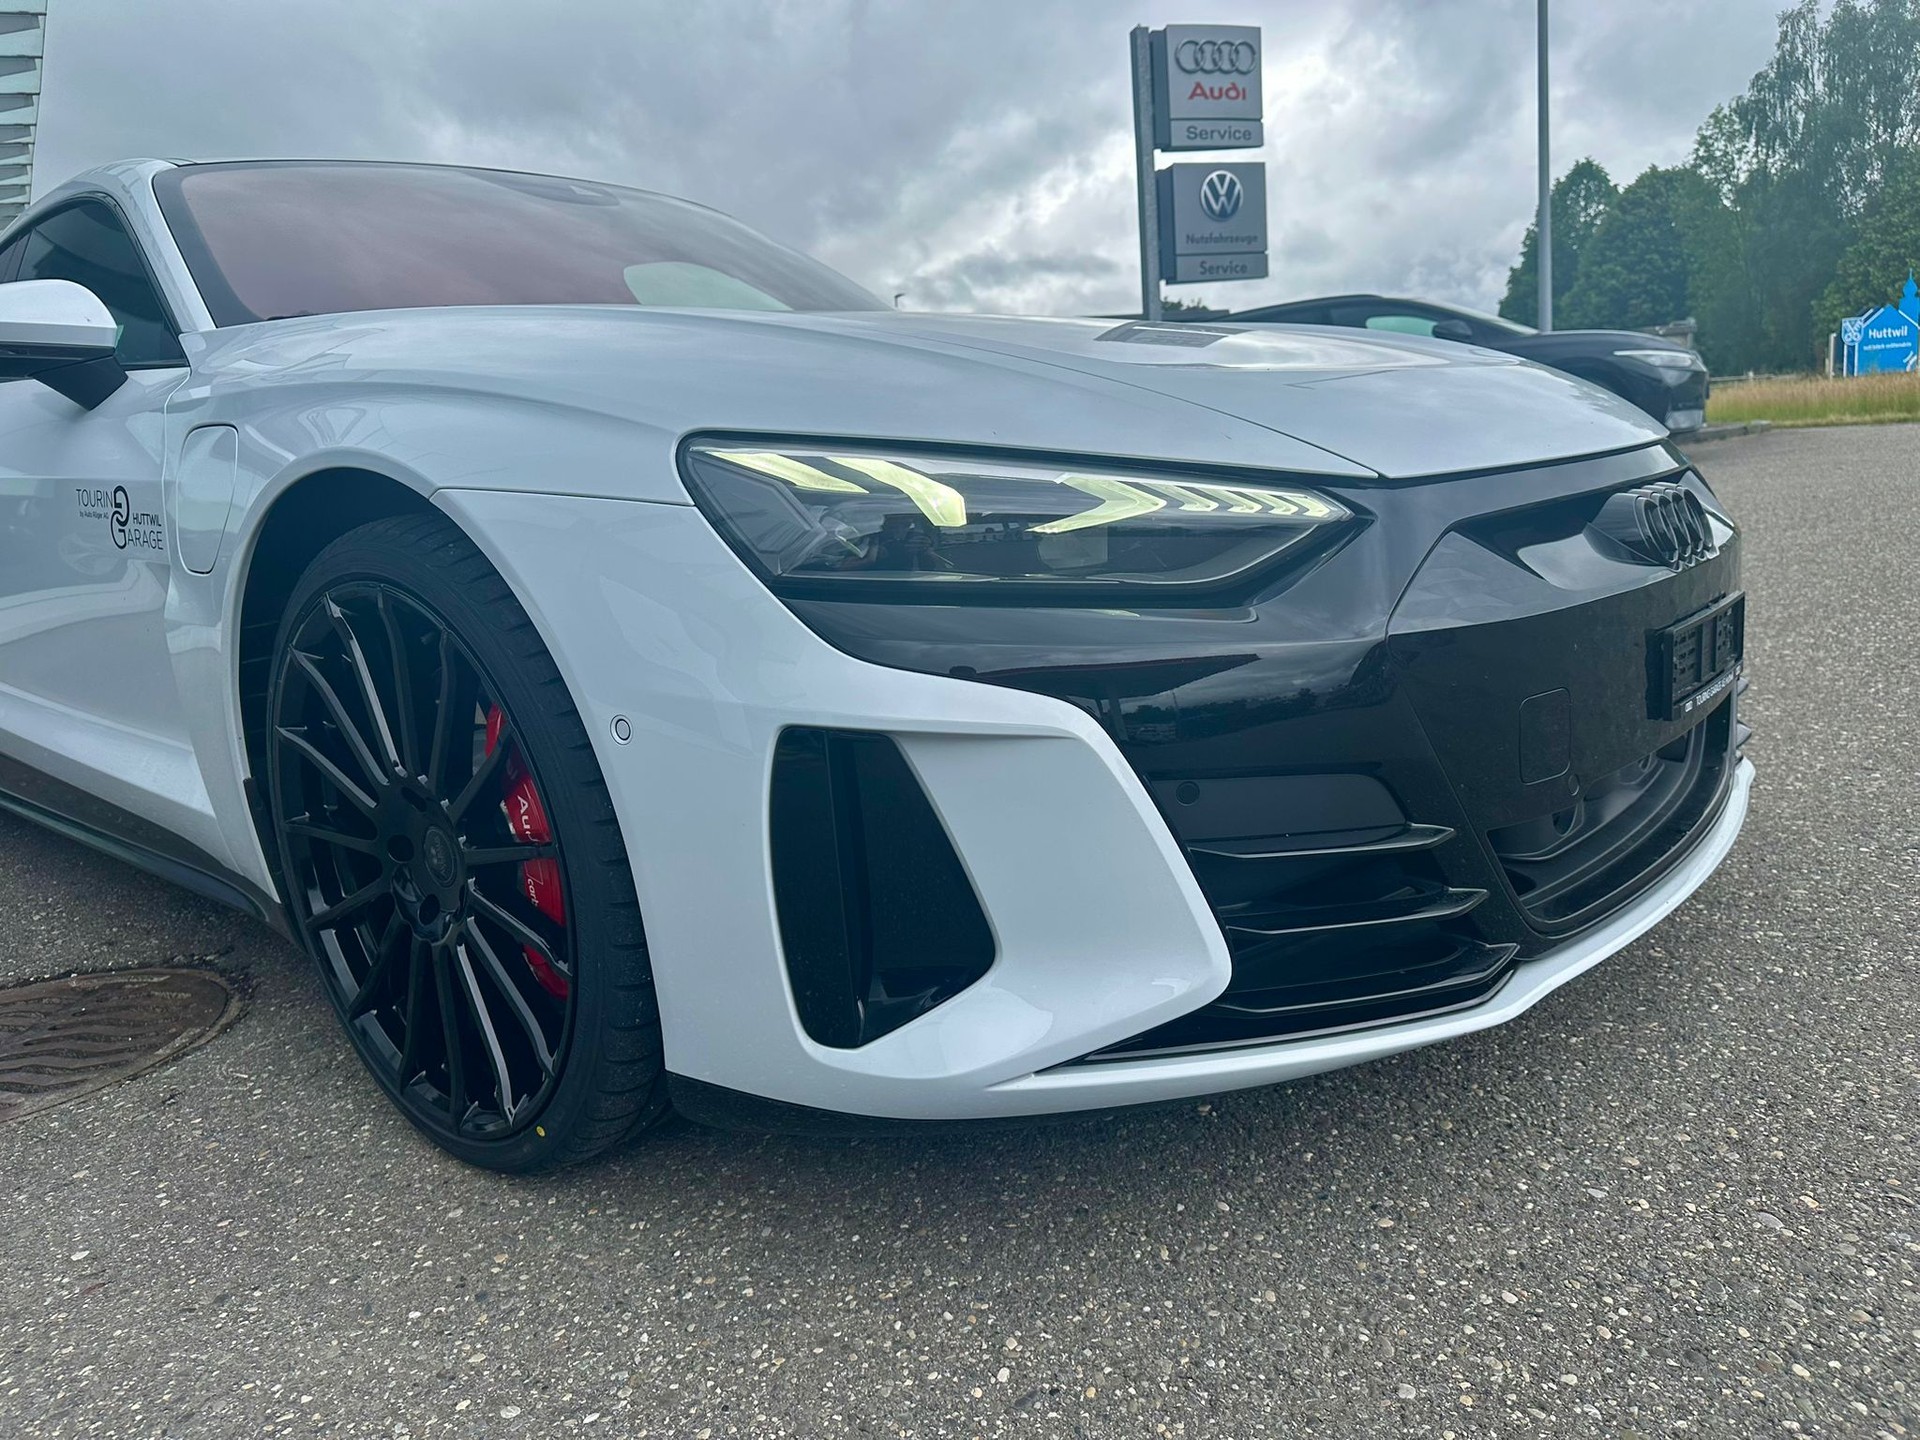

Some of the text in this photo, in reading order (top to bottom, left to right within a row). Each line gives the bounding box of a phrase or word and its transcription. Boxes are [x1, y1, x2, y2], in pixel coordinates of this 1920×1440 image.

[1188, 82, 1246, 100] Audi
[1186, 125, 1252, 140] Service
[1186, 232, 1258, 245] Nutzfahrzeuge
[1200, 260, 1248, 275] Service
[1868, 325, 1908, 339] Huttwil
[132, 512, 162, 527] HUTTWIL
[516, 795, 531, 835] Au
